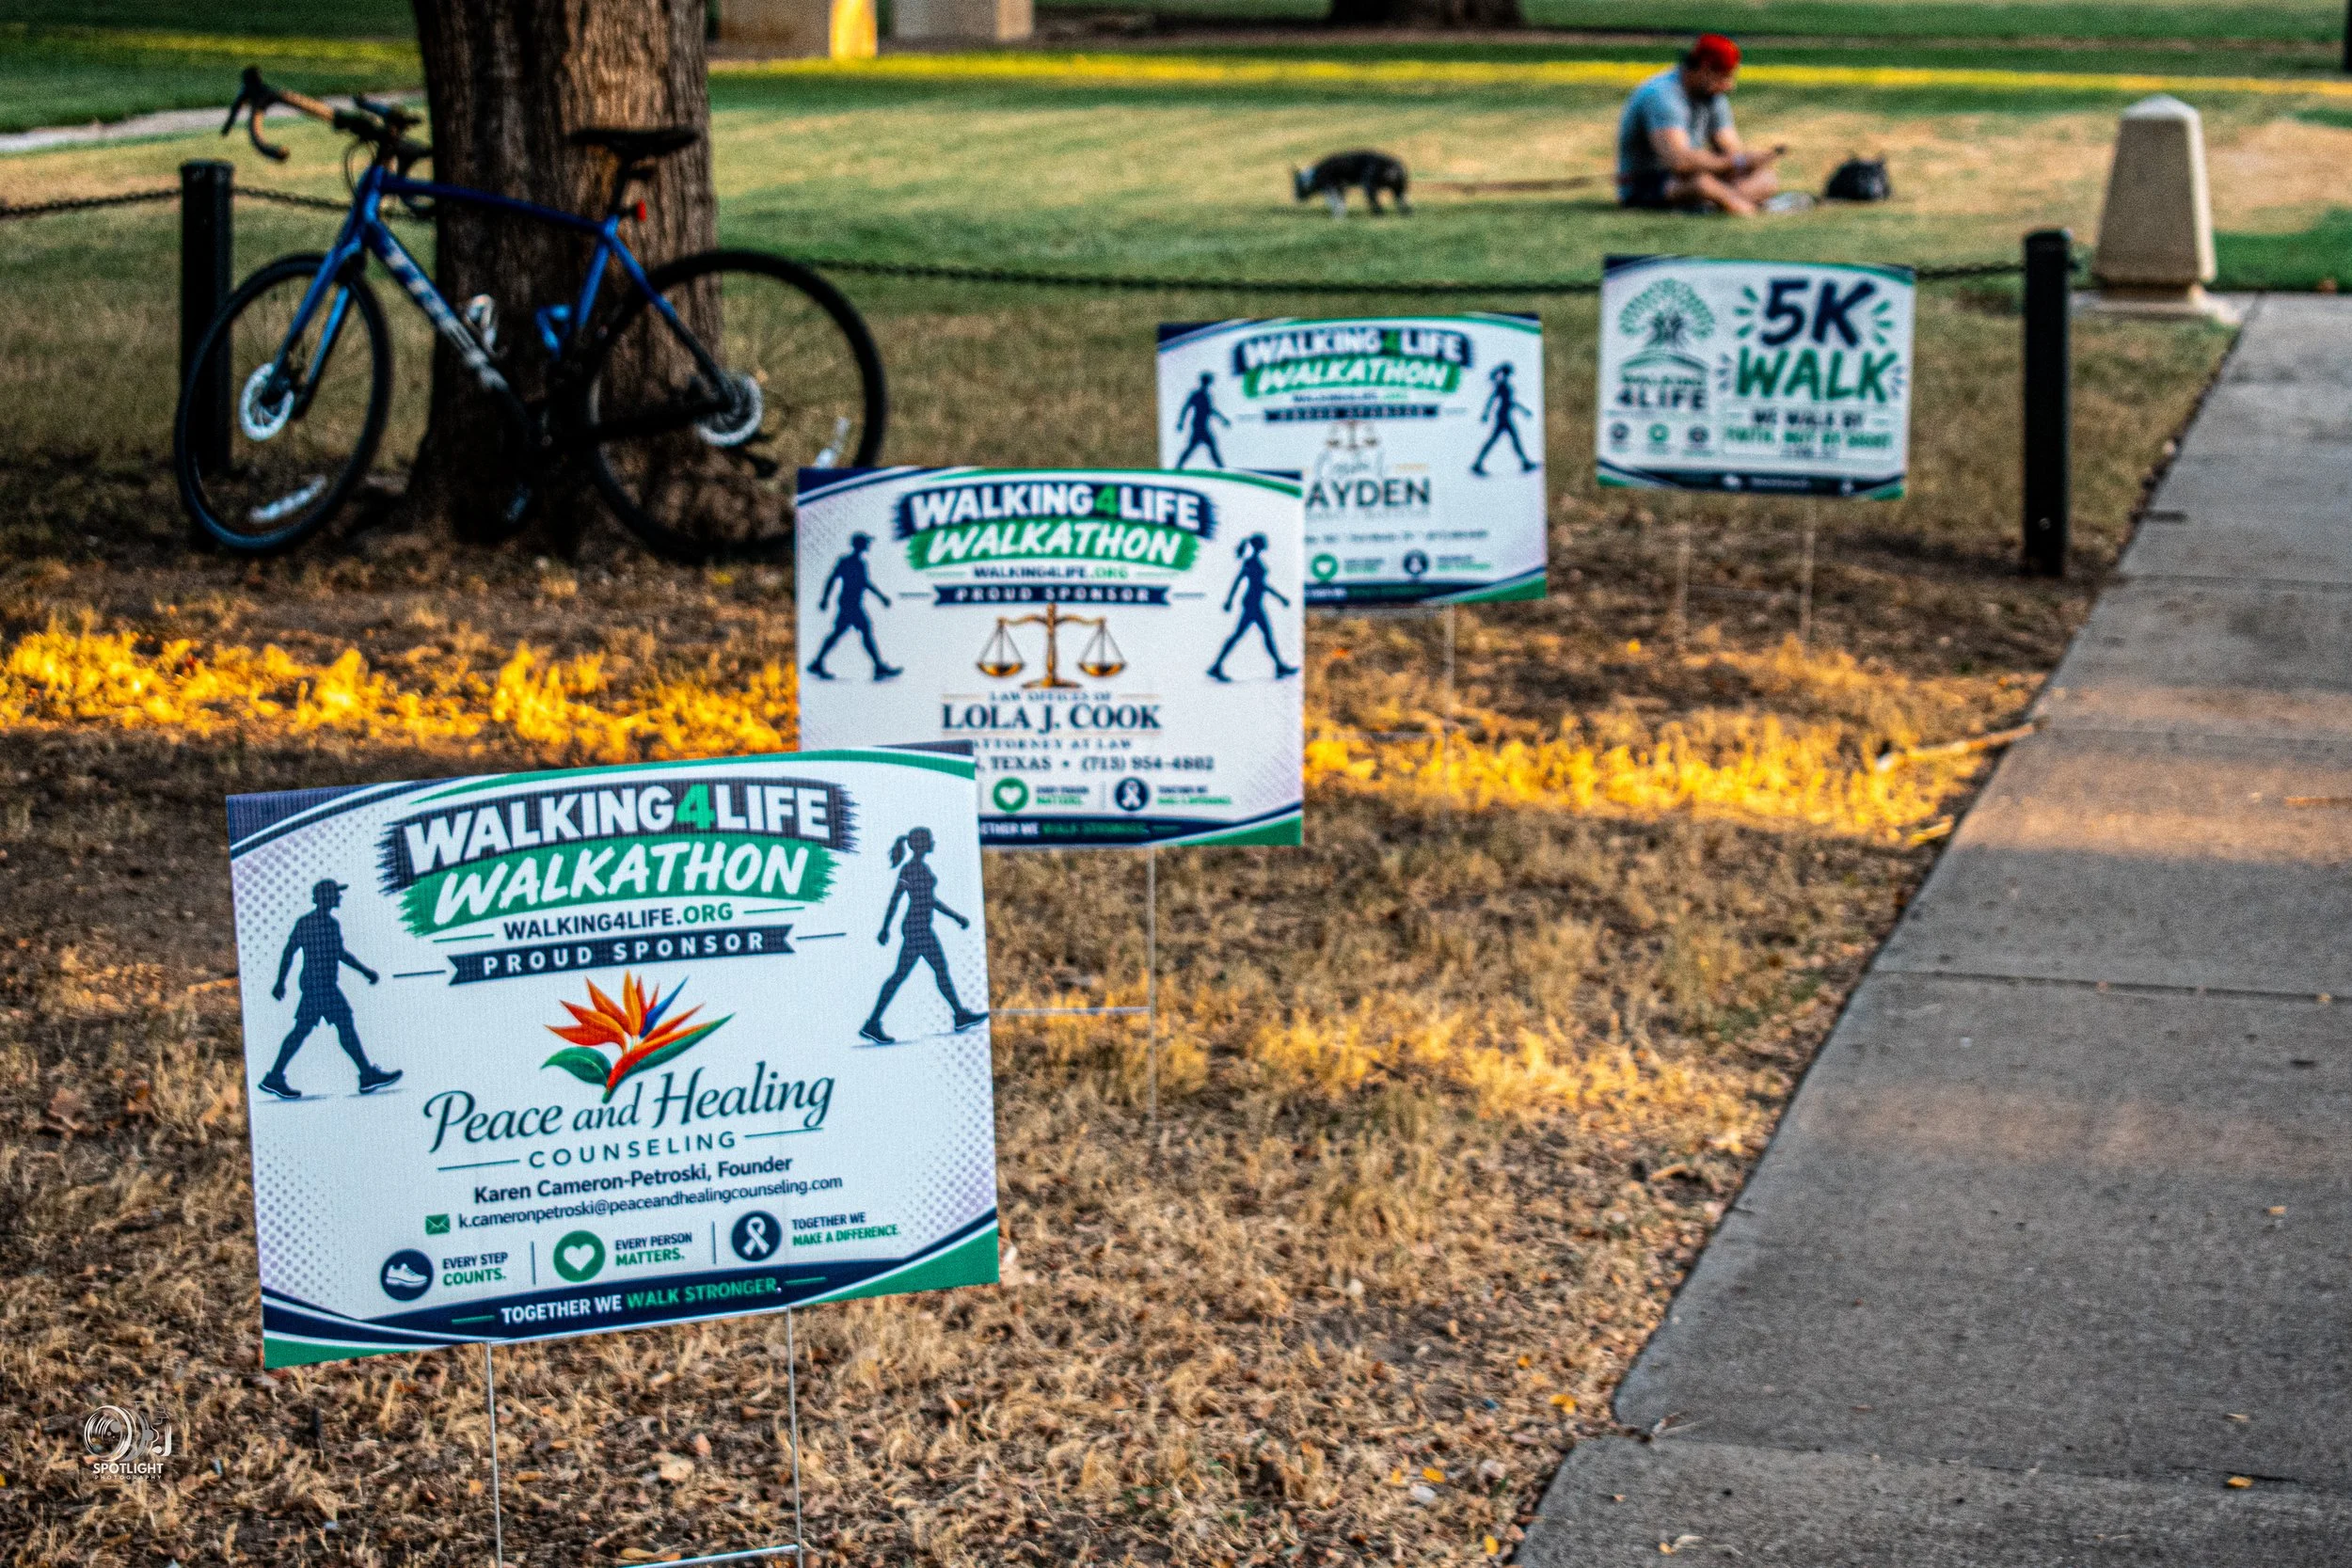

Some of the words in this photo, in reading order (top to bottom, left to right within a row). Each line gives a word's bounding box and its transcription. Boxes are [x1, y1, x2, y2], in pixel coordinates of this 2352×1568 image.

[1761, 278, 1876, 346] 5K
[1257, 358, 1450, 392] WALKATHON
[1736, 346, 1899, 403] WALK
[1617, 389, 1707, 409] 4LIFE
[911, 483, 1202, 530] WALKING4LIFE
[1305, 479, 1430, 508] AYDEN
[927, 521, 1182, 564] WALKATHON
[973, 565, 1128, 579] WALKING4LIFE.ORG
[955, 587, 1032, 601] PROUD
[1045, 587, 1150, 601] SPONSOR
[989, 691, 1021, 701] LAW
[942, 704, 1032, 730] LOLA
[1039, 704, 1060, 734] J.
[1069, 704, 1162, 730] COOK
[991, 755, 1051, 770] TEXAS
[405, 784, 831, 875] WALKING4LIFE
[433, 841, 809, 926] WALKATHON
[503, 902, 733, 940] WALKING4LIFE.ORG
[483, 946, 593, 975] PROUD
[614, 932, 763, 961] SPONSOR
[423, 1090, 563, 1153] Peace
[573, 1082, 644, 1130] and
[652, 1060, 835, 1129] Healing
[529, 1131, 736, 1167] COUNSELING
[474, 1183, 532, 1203] Karen
[537, 1164, 712, 1197] Cameron-Petroski,
[718, 1156, 792, 1178] Founder
[458, 1175, 843, 1228] k.cameronpetroski@peaceandhealingcounseling.com
[792, 1214, 849, 1230] TOGETHER
[851, 1212, 866, 1225] WE
[792, 1231, 822, 1246] MAKE
[825, 1230, 834, 1243] A
[835, 1225, 900, 1243] DIFFERENCE.
[614, 1236, 646, 1251] EVERY
[649, 1232, 692, 1247] PERSON
[614, 1247, 685, 1266] MATTERS.
[443, 1256, 476, 1270] EVERY
[481, 1252, 508, 1265] STEP
[443, 1268, 506, 1286] COUNTS.
[501, 1299, 591, 1324] TOGETHER
[594, 1294, 622, 1314] WE
[627, 1287, 679, 1310] WALK
[685, 1277, 782, 1303] STRONGER.
